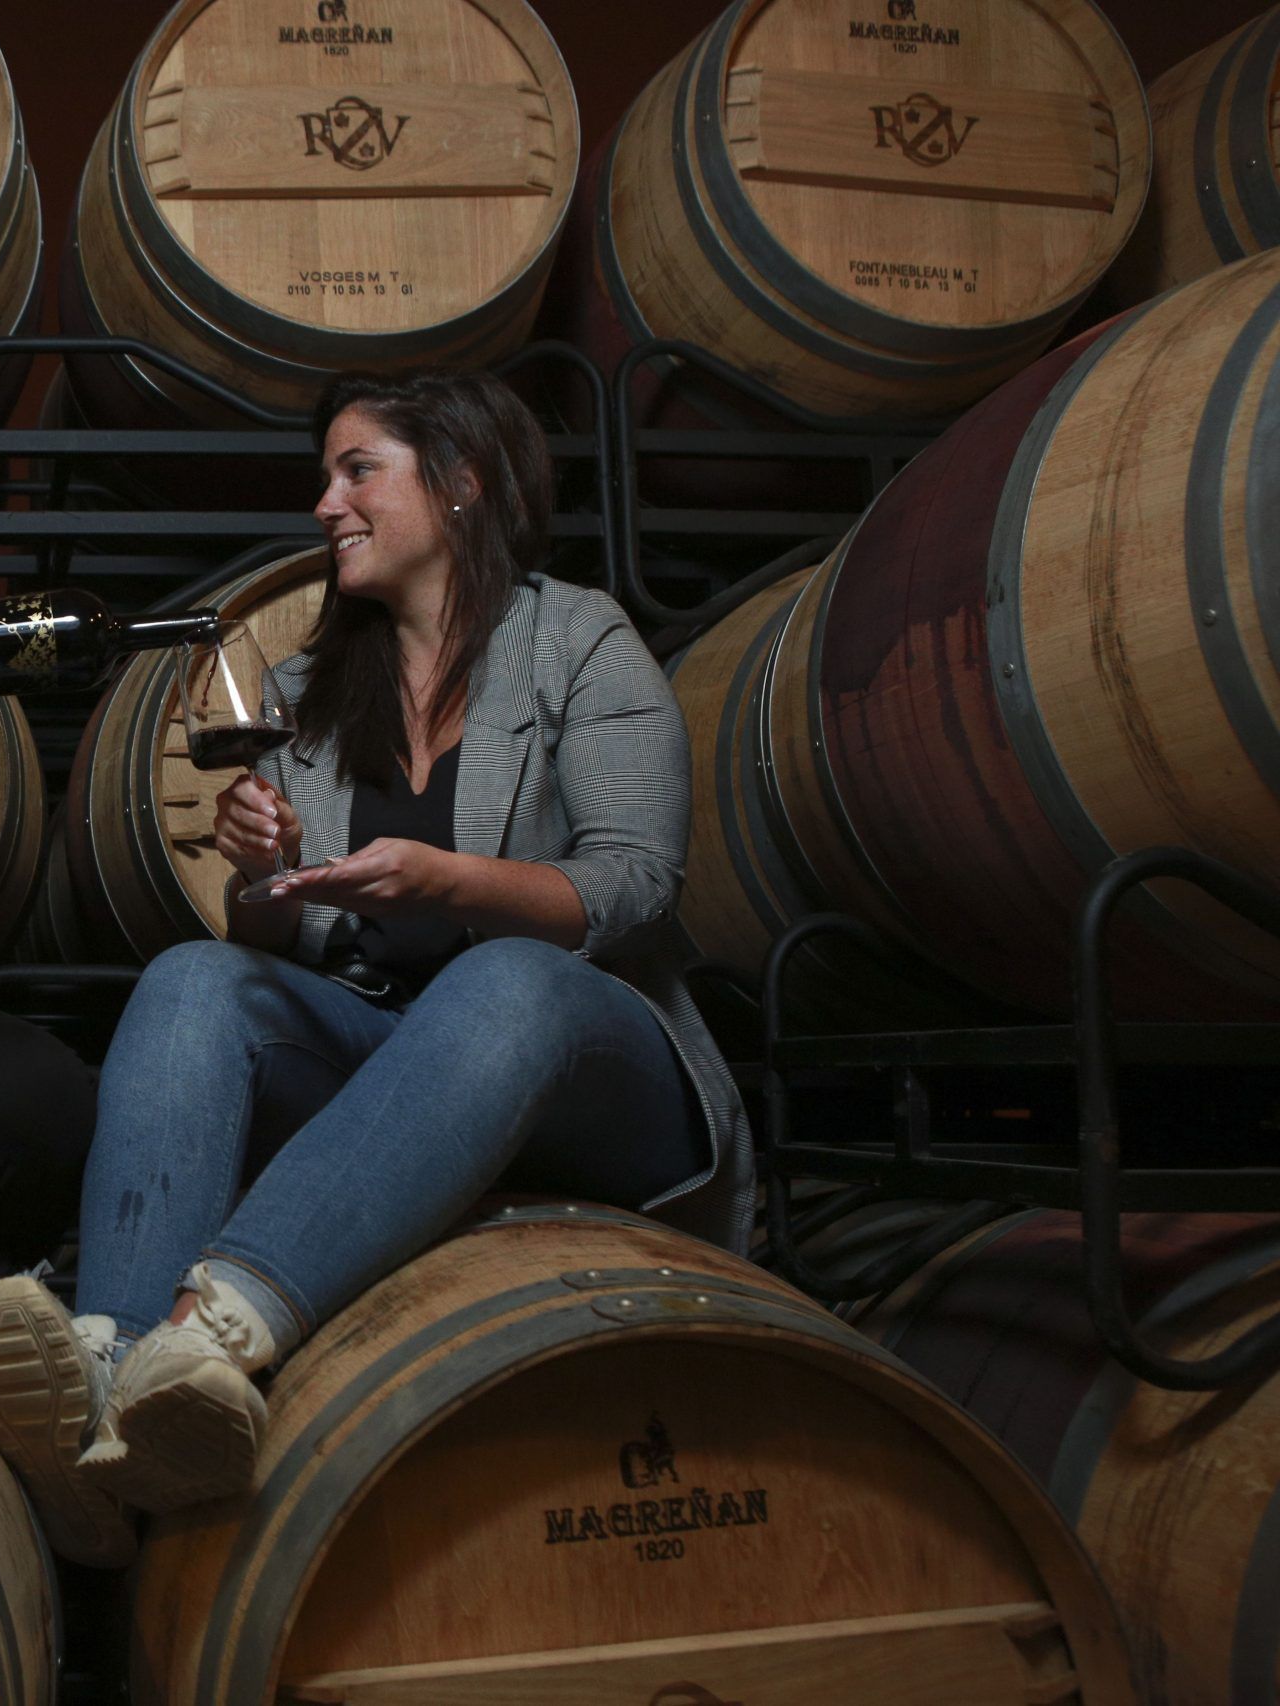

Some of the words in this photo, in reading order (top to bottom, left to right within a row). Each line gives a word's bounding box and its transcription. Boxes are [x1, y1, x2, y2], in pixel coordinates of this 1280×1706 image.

[278, 24, 393, 43] MAGREÑAN
[849, 21, 960, 45] MAGREÑAN
[849, 260, 948, 280] FONTAINEBLEAU
[970, 269, 979, 281] T
[287, 285, 311, 296] 0110
[333, 285, 344, 295] 10
[349, 285, 365, 295] SA
[375, 285, 386, 295] 13
[545, 1487, 768, 1544] MAGREÑAN
[634, 1538, 685, 1562] 1820
